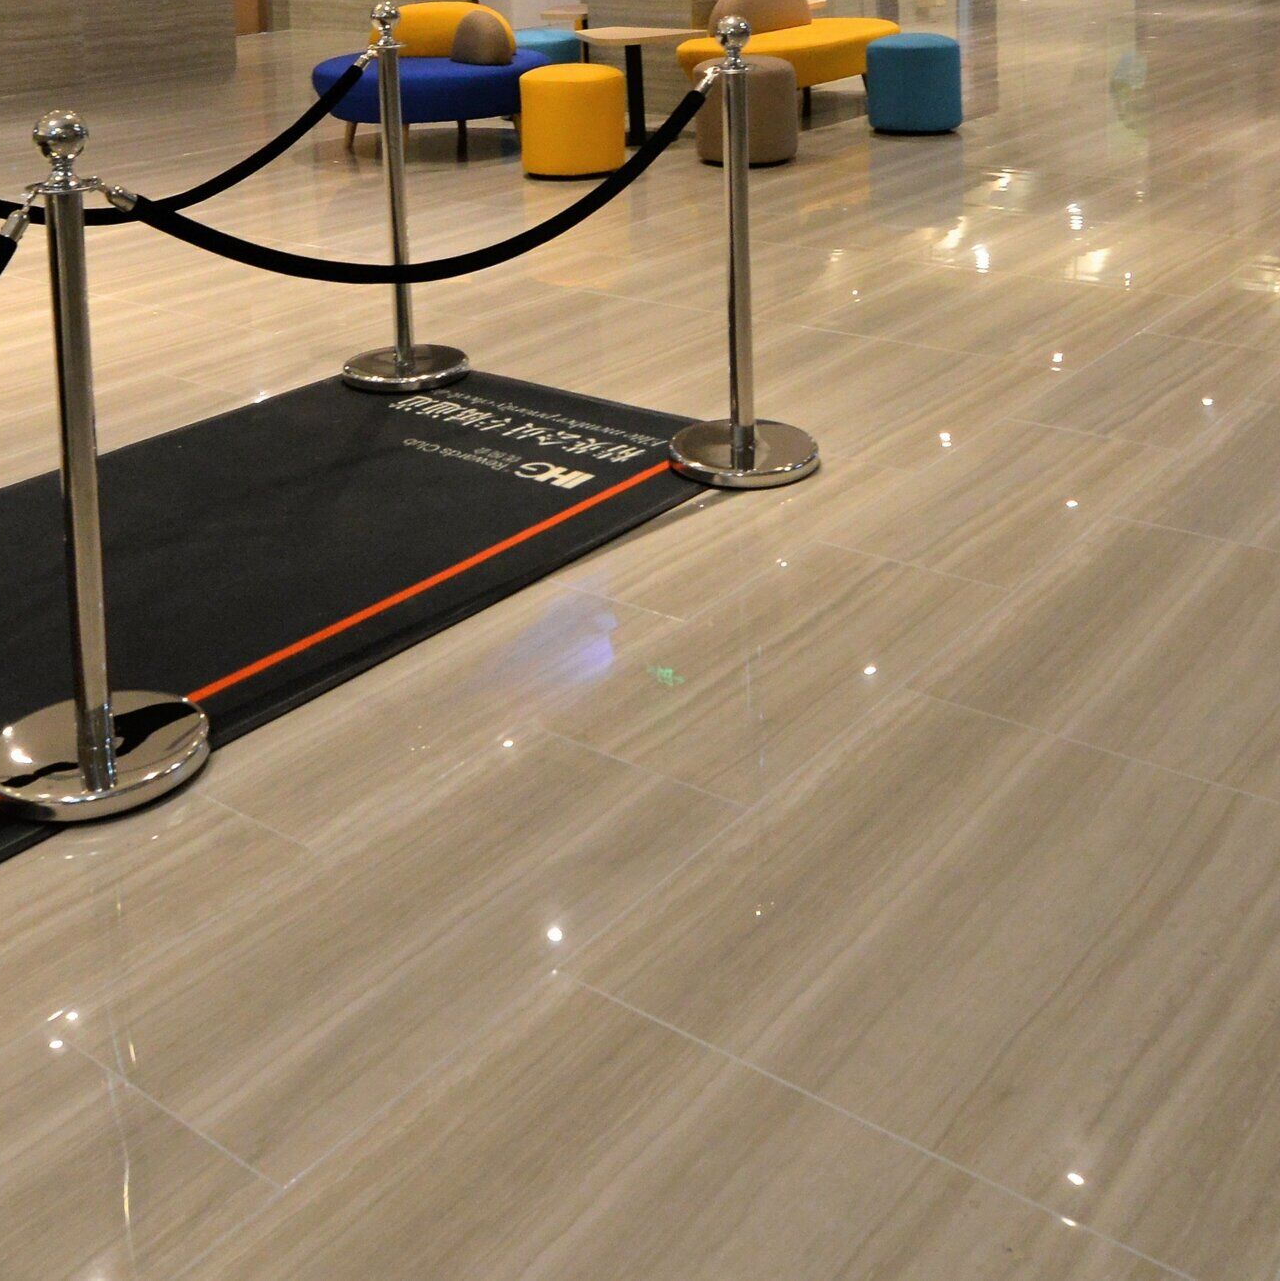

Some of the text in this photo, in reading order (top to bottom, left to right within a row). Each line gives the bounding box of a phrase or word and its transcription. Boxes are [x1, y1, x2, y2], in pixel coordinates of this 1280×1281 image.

[403, 438, 510, 471] Rewards Club
[513, 461, 596, 490] IHG
